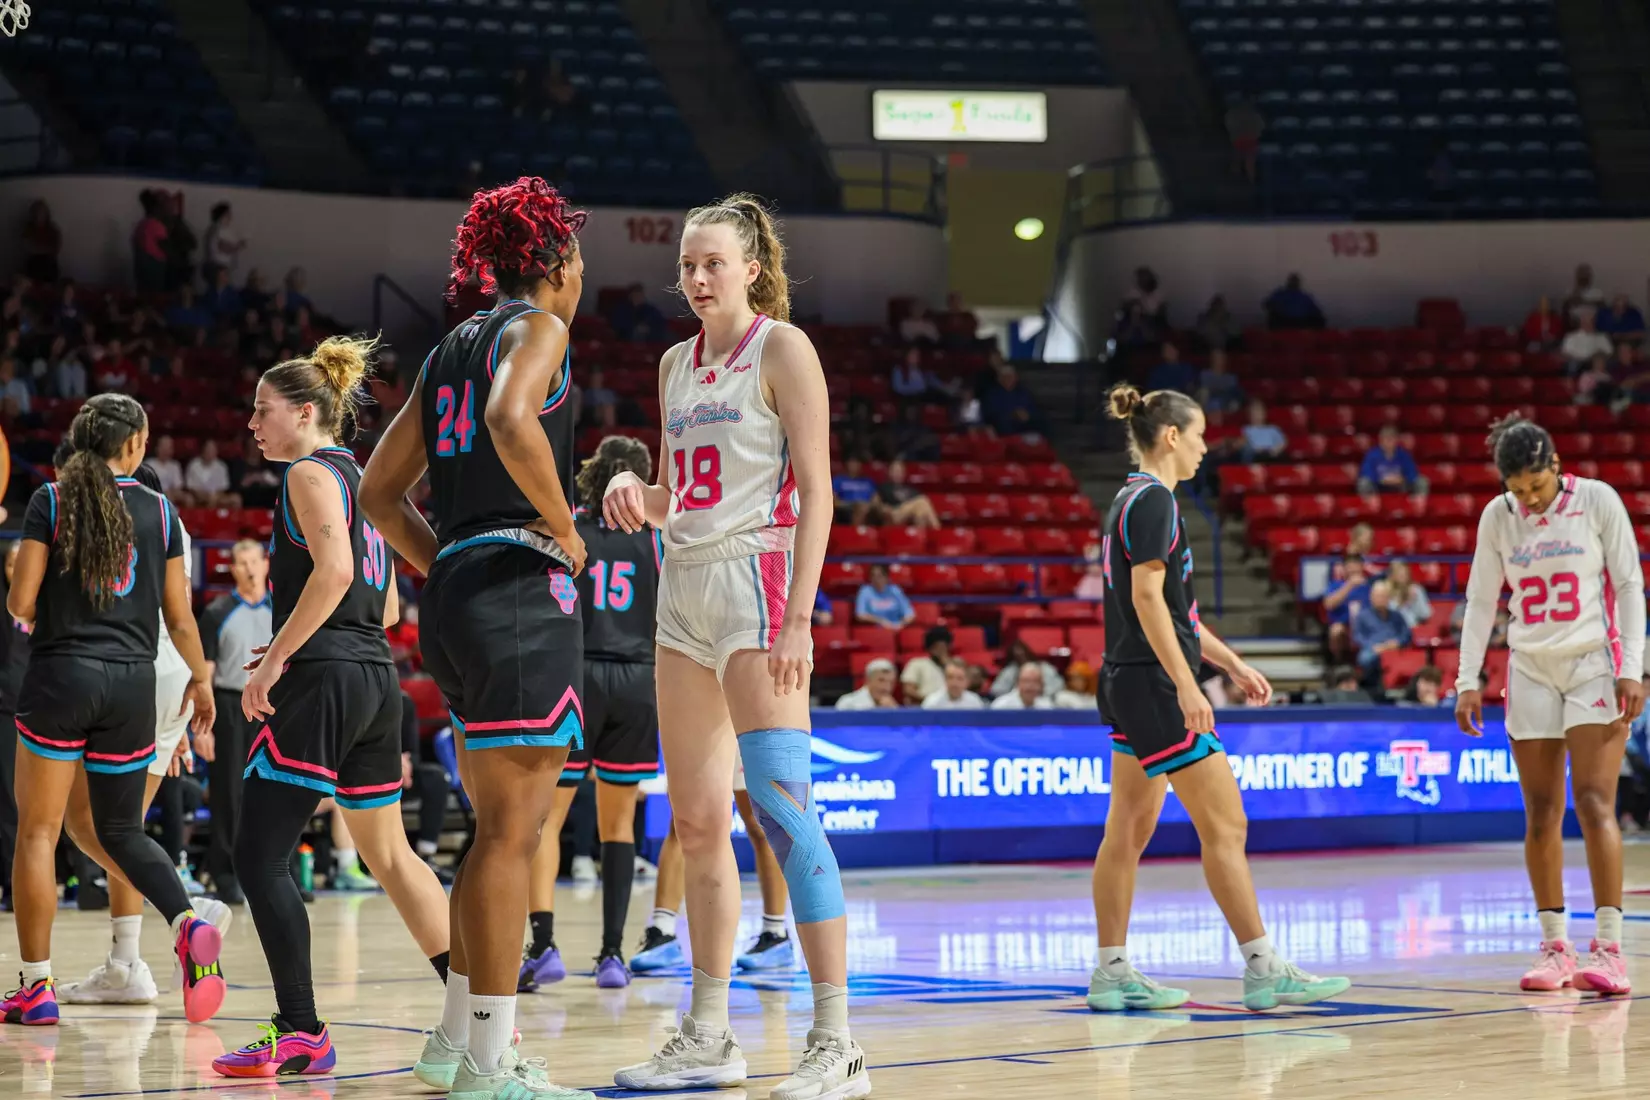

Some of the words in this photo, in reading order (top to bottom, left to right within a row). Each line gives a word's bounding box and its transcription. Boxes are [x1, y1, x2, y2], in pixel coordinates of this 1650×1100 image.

[626, 215, 674, 244] 102
[1328, 231, 1379, 257] 103
[436, 379, 476, 457] 24
[673, 444, 722, 513] 18
[363, 520, 386, 591] 30
[588, 559, 636, 611] 15
[1519, 571, 1580, 625] 23
[813, 772, 896, 801] ouisiana
[931, 759, 990, 797] THE
[993, 757, 1111, 795] OFFICIAL
[1226, 752, 1336, 790] PARTNER
[1337, 751, 1370, 788] OF
